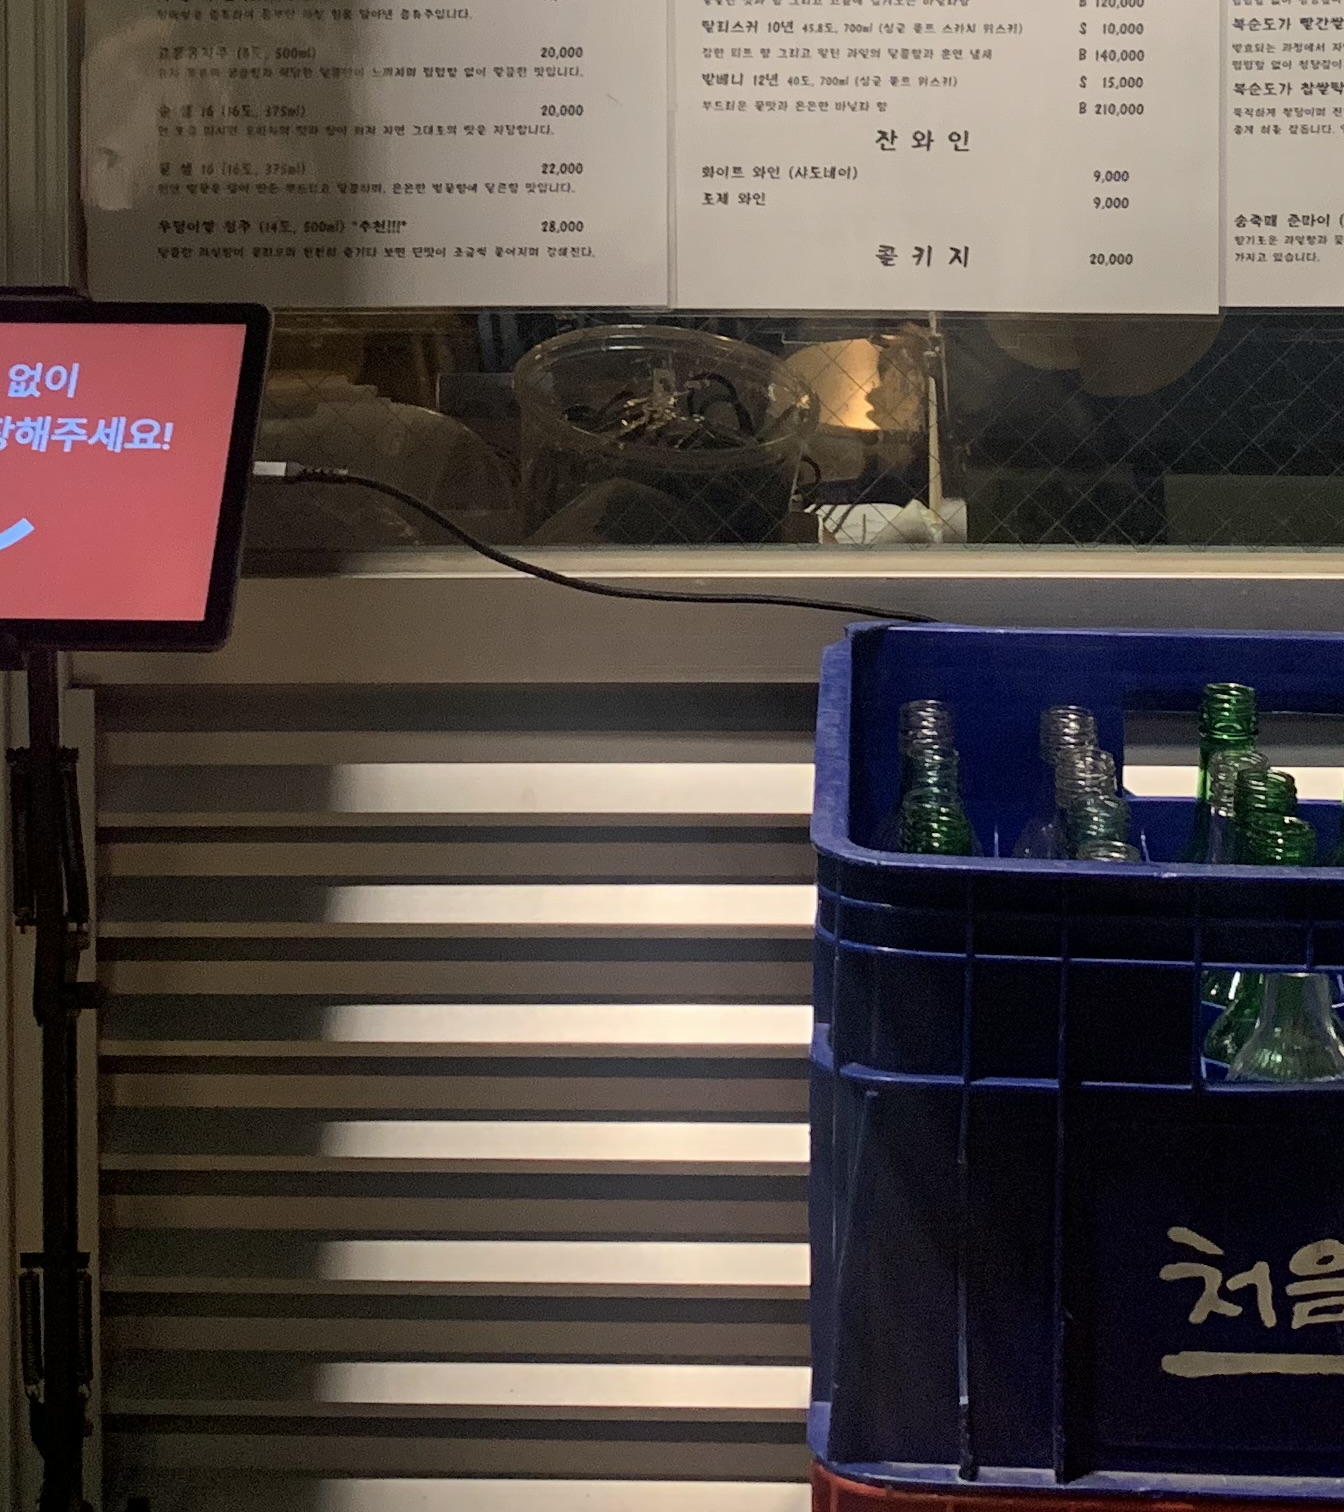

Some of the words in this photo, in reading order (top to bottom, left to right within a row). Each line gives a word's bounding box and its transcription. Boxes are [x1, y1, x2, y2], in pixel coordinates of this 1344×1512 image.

[1102, 21, 1145, 37] 10,000
[539, 45, 584, 61] 20,000
[1094, 48, 1146, 64] 140,000
[1102, 75, 1145, 90] 15,000
[539, 103, 585, 118] 20,000
[1094, 102, 1145, 117] 210,000
[540, 161, 584, 177] 22,000
[701, 165, 745, 180] 화이트
[752, 165, 781, 180] 와인
[1092, 169, 1131, 184] 9,000
[737, 191, 766, 207] 와인
[1092, 195, 1130, 210] 9,000
[540, 219, 585, 235] 28,000
[1088, 252, 1134, 267] 20,000
[7, 362, 81, 399] 없이
